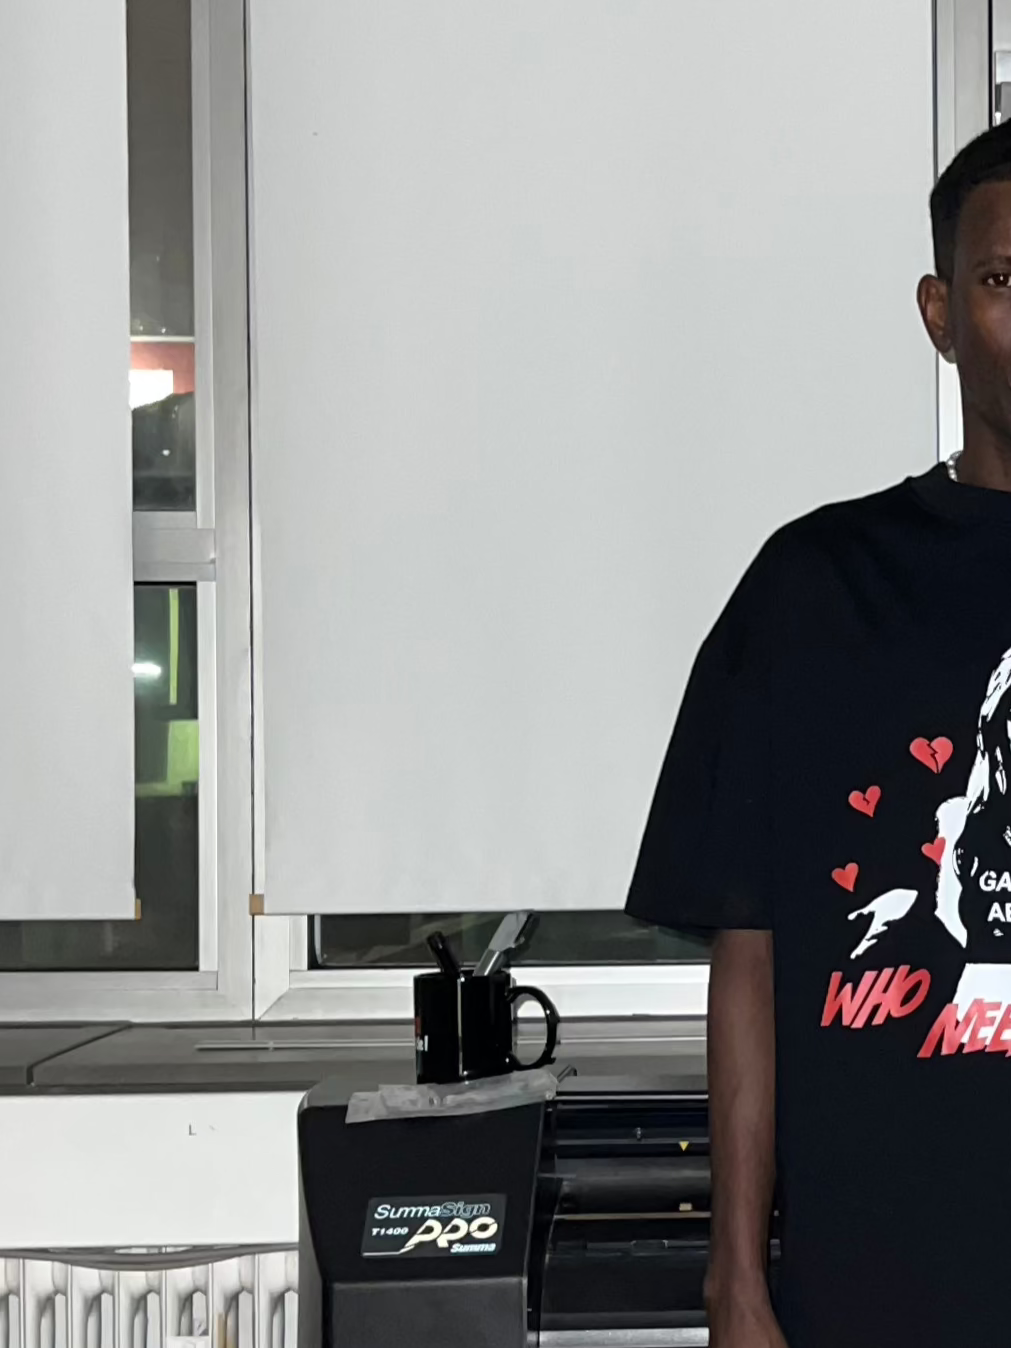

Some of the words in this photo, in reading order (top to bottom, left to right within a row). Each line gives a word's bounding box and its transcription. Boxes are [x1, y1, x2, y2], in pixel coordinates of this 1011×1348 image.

[821, 965, 931, 1029] WHO
[371, 1227, 409, 1236] T1400
[450, 1243, 496, 1253] Summa
